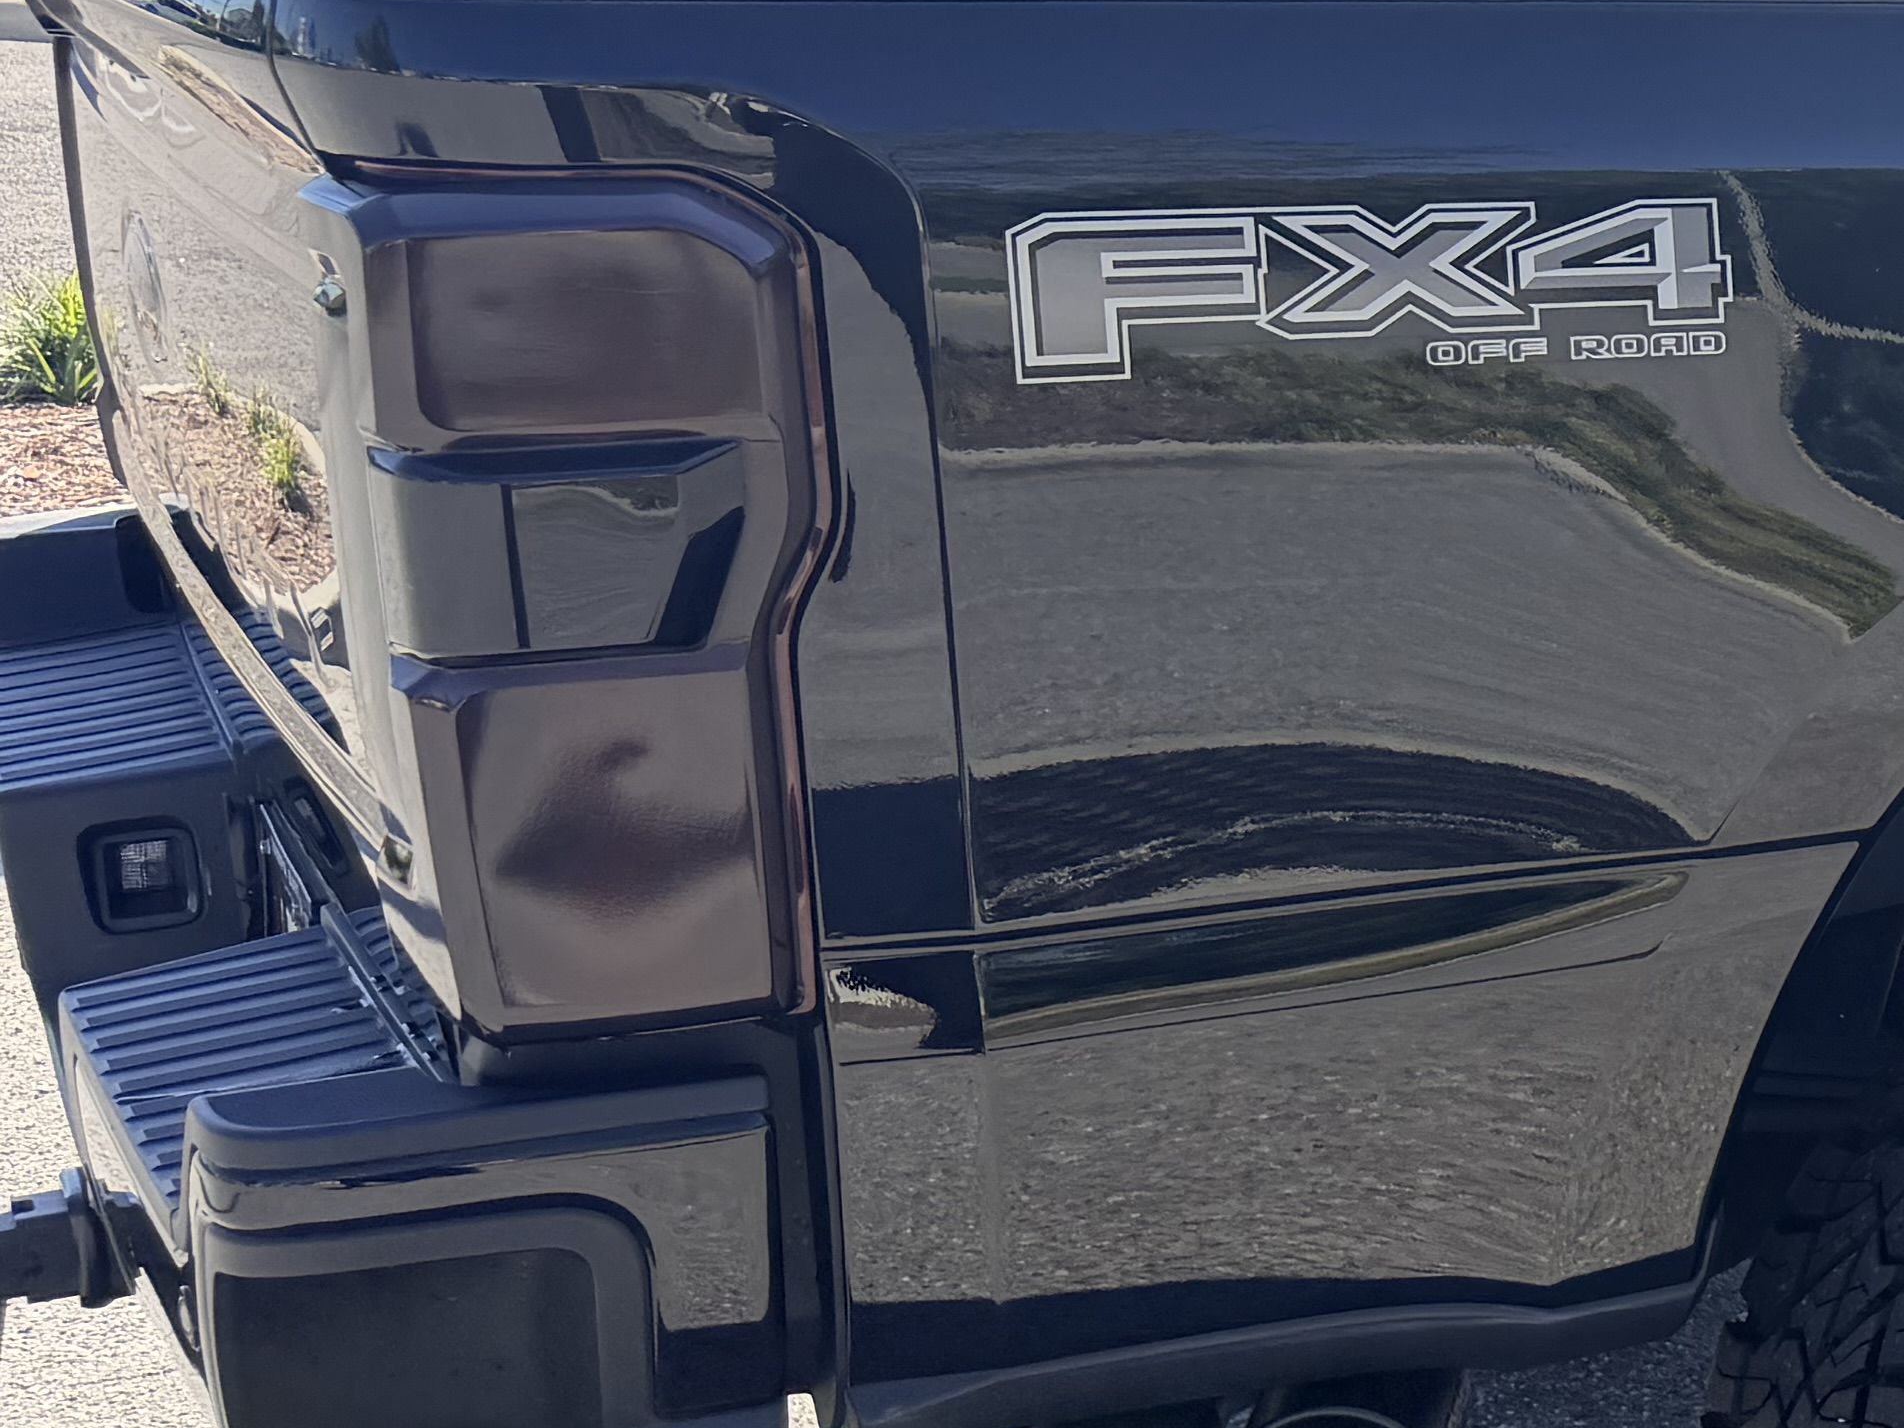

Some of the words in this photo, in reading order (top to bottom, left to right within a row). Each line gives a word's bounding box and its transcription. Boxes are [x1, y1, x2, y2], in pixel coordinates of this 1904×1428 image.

[1004, 198, 1733, 385] FX4
[1425, 336, 1547, 367] OFF
[1569, 331, 1728, 361] ROAD
